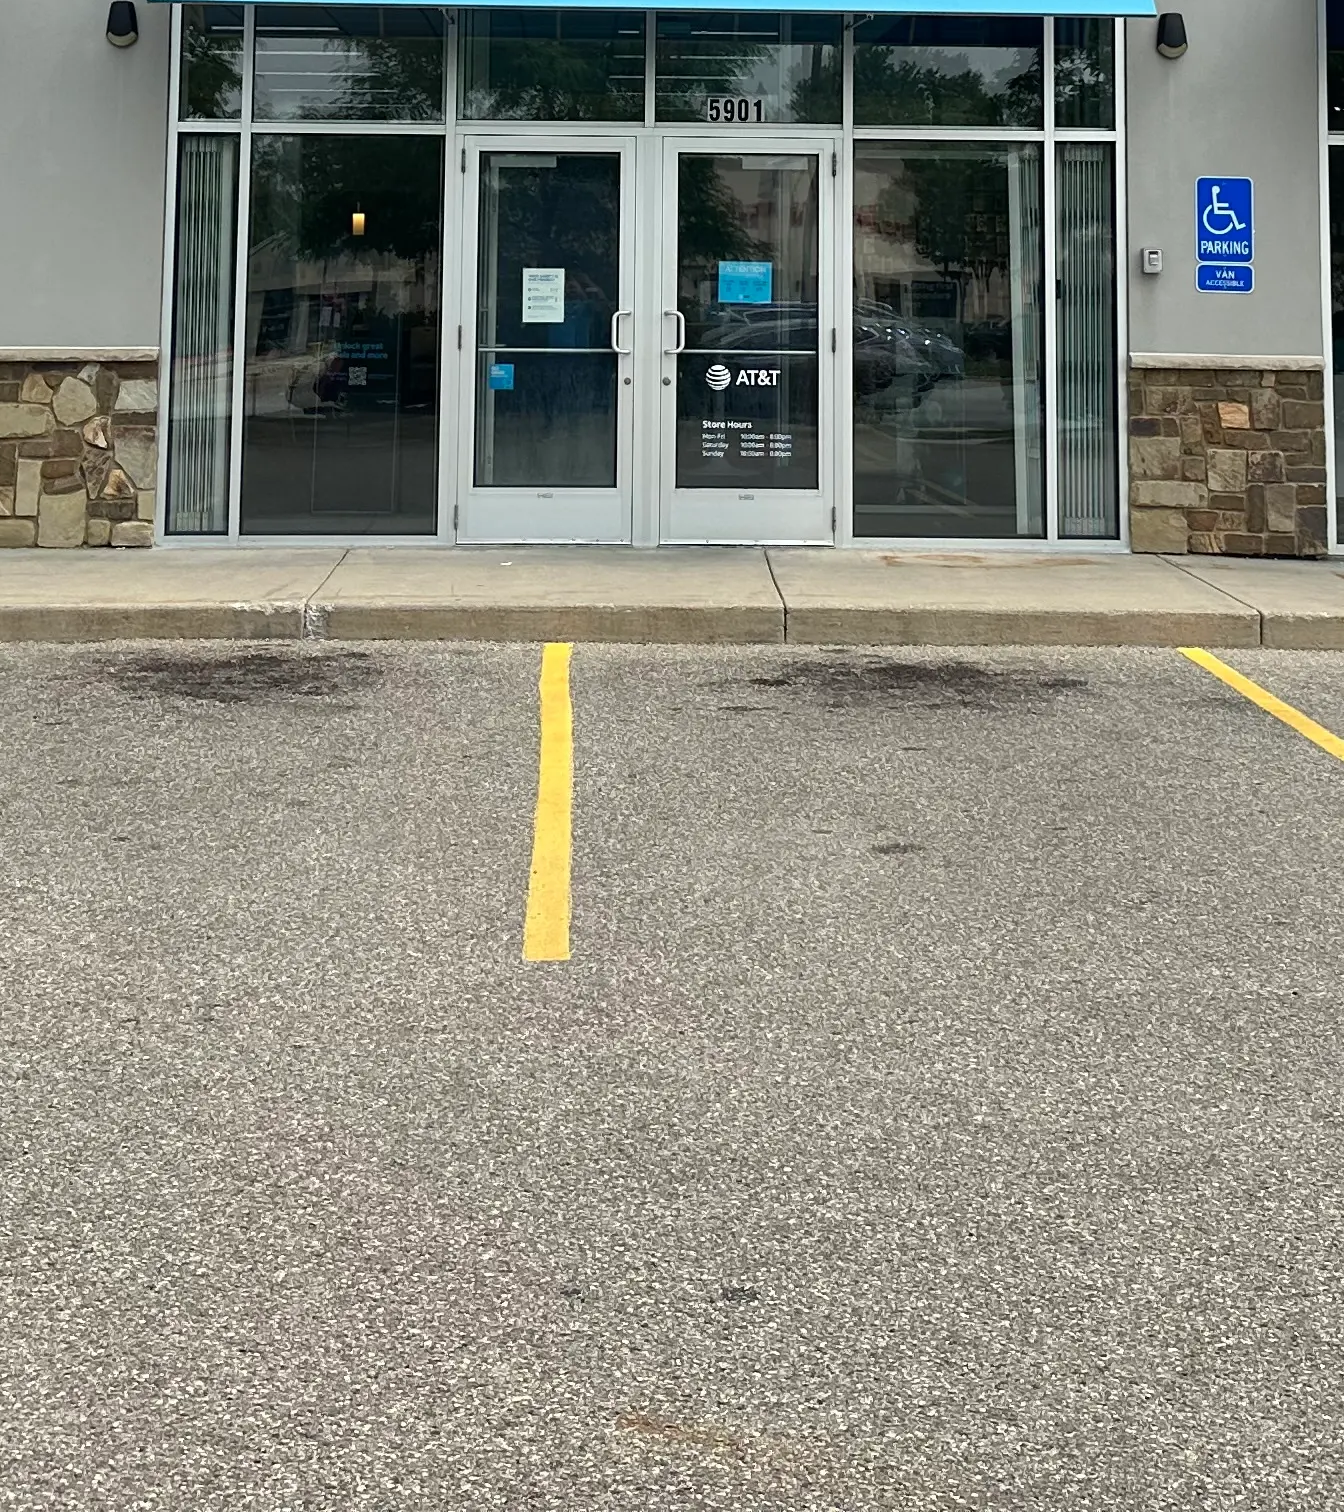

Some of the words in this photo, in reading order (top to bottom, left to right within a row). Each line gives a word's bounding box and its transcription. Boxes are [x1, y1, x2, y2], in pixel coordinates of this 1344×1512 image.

[709, 98, 762, 121] 5901
[1200, 240, 1249, 255] PARKING
[1215, 269, 1235, 279] VAN
[1206, 279, 1245, 287] ACCESSIBLE
[735, 369, 782, 386] AT&T
[702, 420, 726, 429] Store
[727, 420, 753, 429] Hours
[702, 450, 725, 458] Sunday
